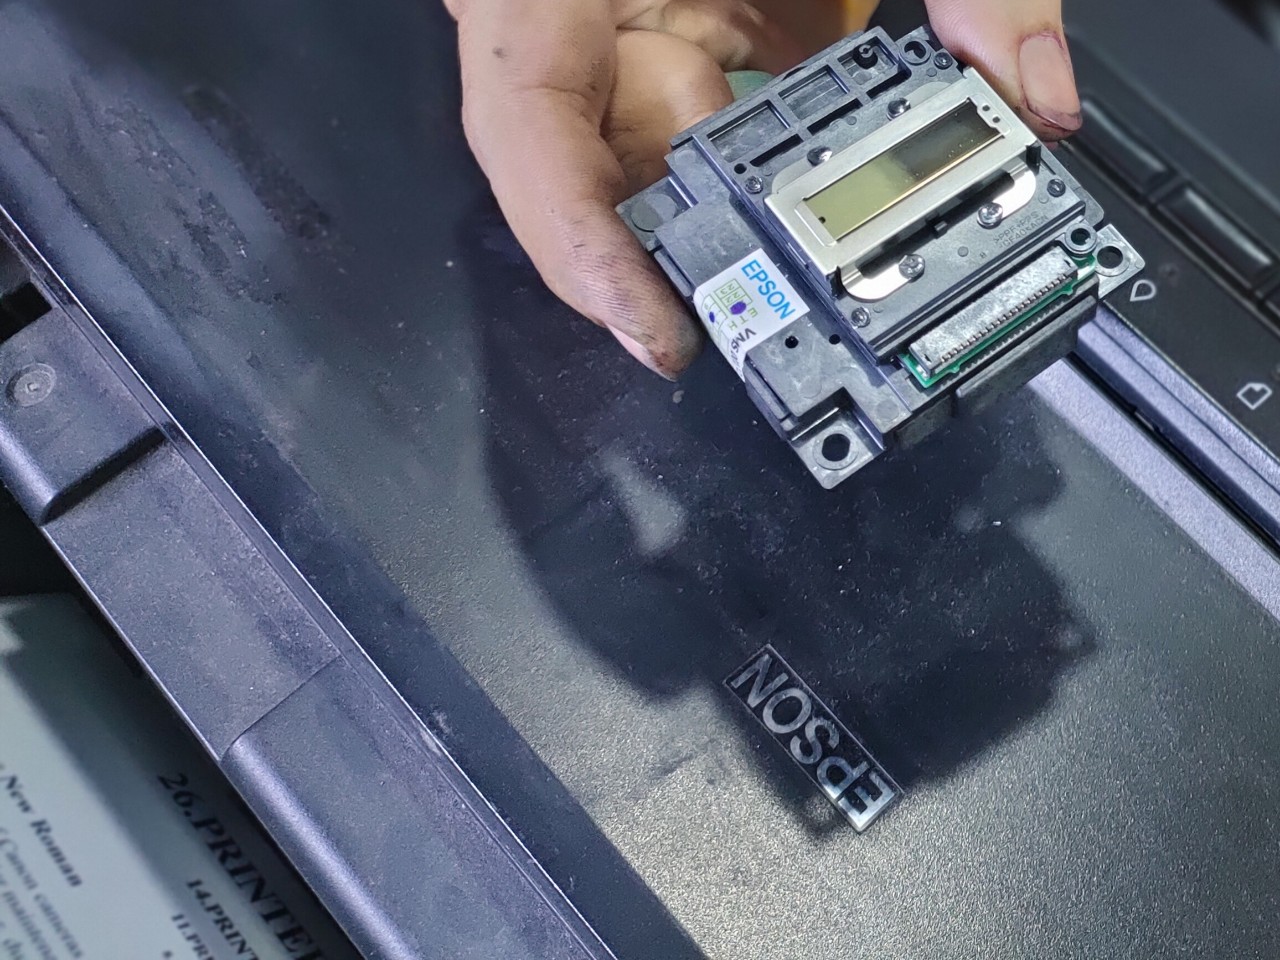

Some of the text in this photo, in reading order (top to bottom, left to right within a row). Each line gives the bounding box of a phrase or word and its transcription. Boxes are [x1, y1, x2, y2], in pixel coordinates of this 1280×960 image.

[741, 259, 796, 320] EPSON
[731, 653, 896, 828] EPSON
[0, 775, 82, 887] New Roman
[34, 893, 83, 959] cameras
[172, 913, 215, 960] 11.PR
